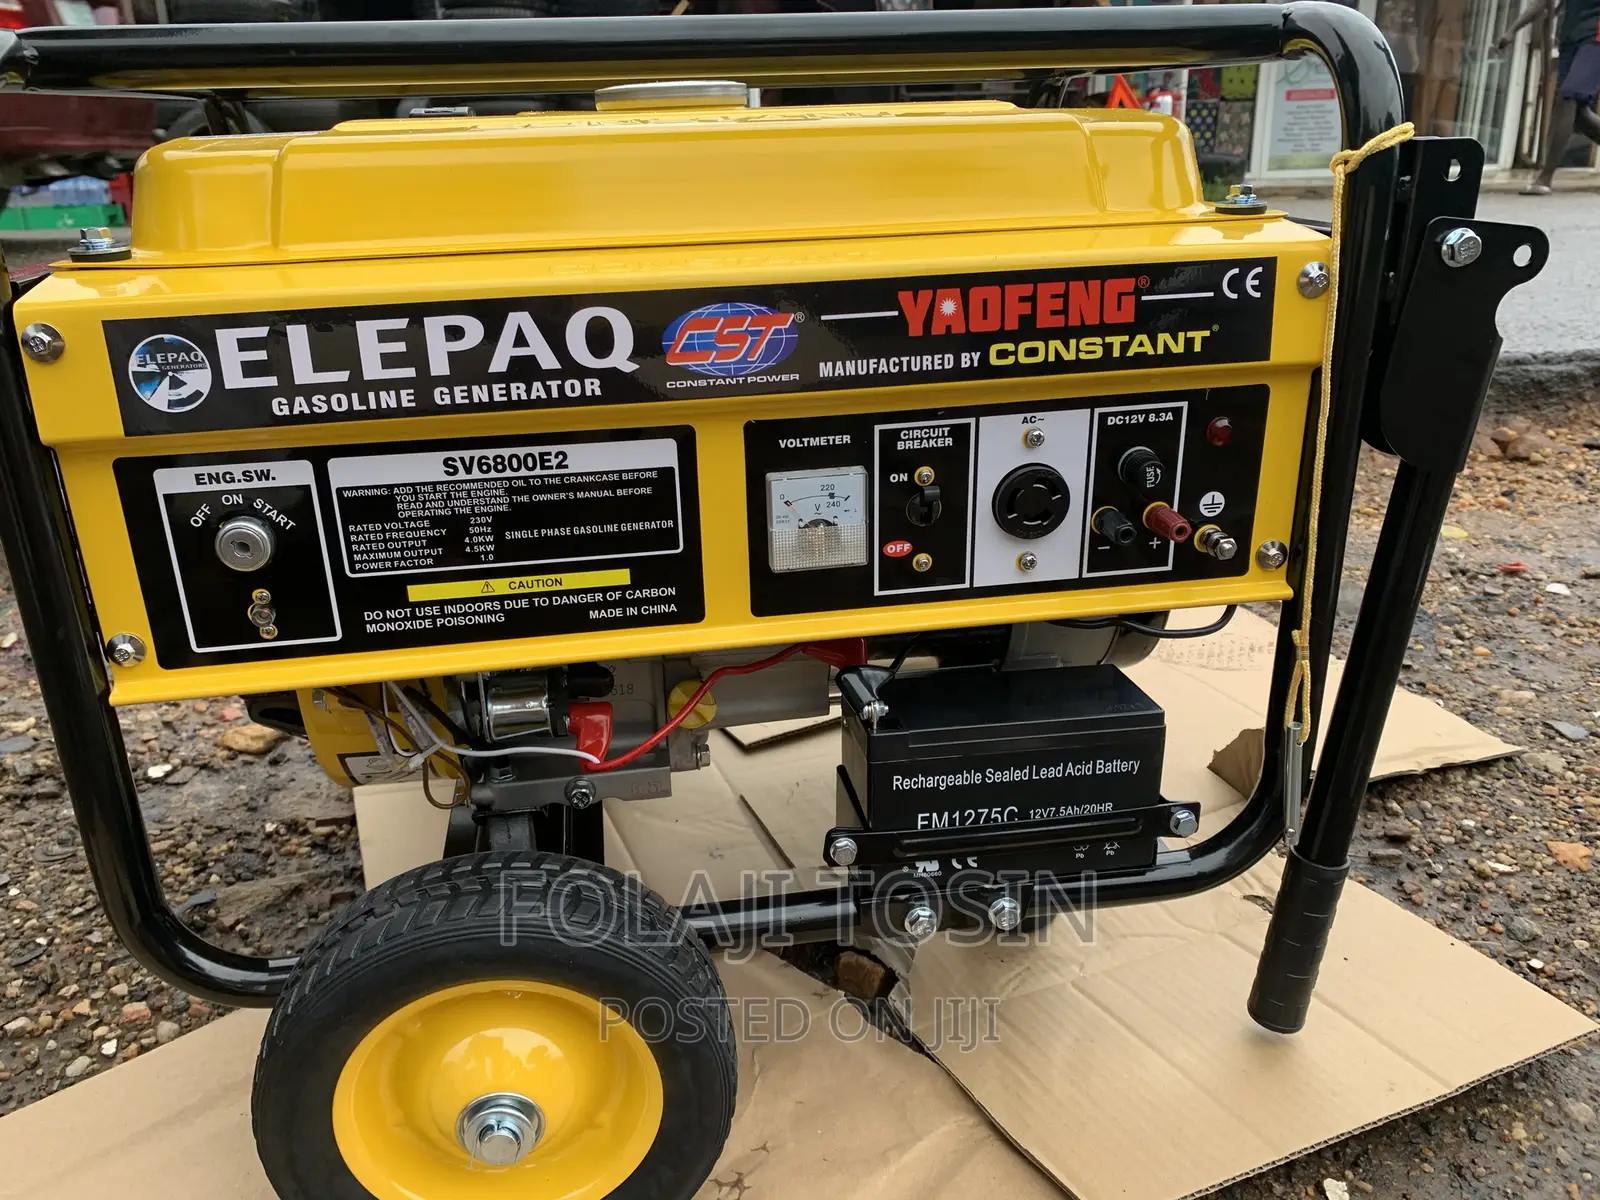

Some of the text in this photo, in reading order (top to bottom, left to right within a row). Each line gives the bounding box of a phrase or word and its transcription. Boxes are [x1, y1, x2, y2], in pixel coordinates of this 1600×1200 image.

[214, 306, 641, 390] ELEPAQ
[136, 351, 203, 365] ELEPAQ
[819, 353, 954, 378] MANUFACTURED
[960, 352, 981, 368] BY
[666, 373, 800, 389] CONSTANT POWER
[271, 378, 603, 417] GASOLINE GENERATOR
[1107, 412, 1174, 426] DC12V 8.3A
[779, 435, 851, 449] VOLTMETER
[900, 427, 950, 440] CIRCUIT
[897, 437, 953, 450] BREAKER
[443, 451, 569, 476] SV6800E2
[194, 469, 277, 486] ENG.SW.
[342, 471, 658, 498] WARNING: ADD THE RECOMMENDED OIL TO THE CRANKCASE BEFORE
[889, 473, 909, 483] ON
[1146, 465, 1156, 488] FUSE
[221, 493, 244, 505] ON
[395, 489, 508, 503] YOU START THE ENGINE.
[397, 487, 653, 511] READ AND UNDERSTAND THE OWNER'S MANUAL BEFORE
[190, 503, 213, 528] OFF
[253, 498, 297, 530] START
[397, 504, 512, 518] OPERATING THE ENGINE.
[348, 516, 493, 532] RATED VOLTAGE 230V
[505, 519, 674, 540] SINGLE PHASE GASOLINE GENERATOR
[350, 526, 492, 542] RATED FREQUENCY 50Hz
[352, 535, 494, 551] RATED OUTPUT 4.0KW
[886, 543, 911, 553] OFF
[353, 544, 495, 561] MAXIMUM OUTPUT 4.5KW
[355, 553, 494, 570] POWER FACTOR 1.0
[508, 577, 563, 591] CAUTION
[364, 586, 677, 621] DO NOT USE INDOORS DUE TO DANGER OF CARBON
[589, 603, 677, 620] MADE IN CHINA
[366, 613, 505, 633] MONOXIDE POISONING
[893, 758, 1141, 791] Rechargeable Sealed Lead Acid Battery
